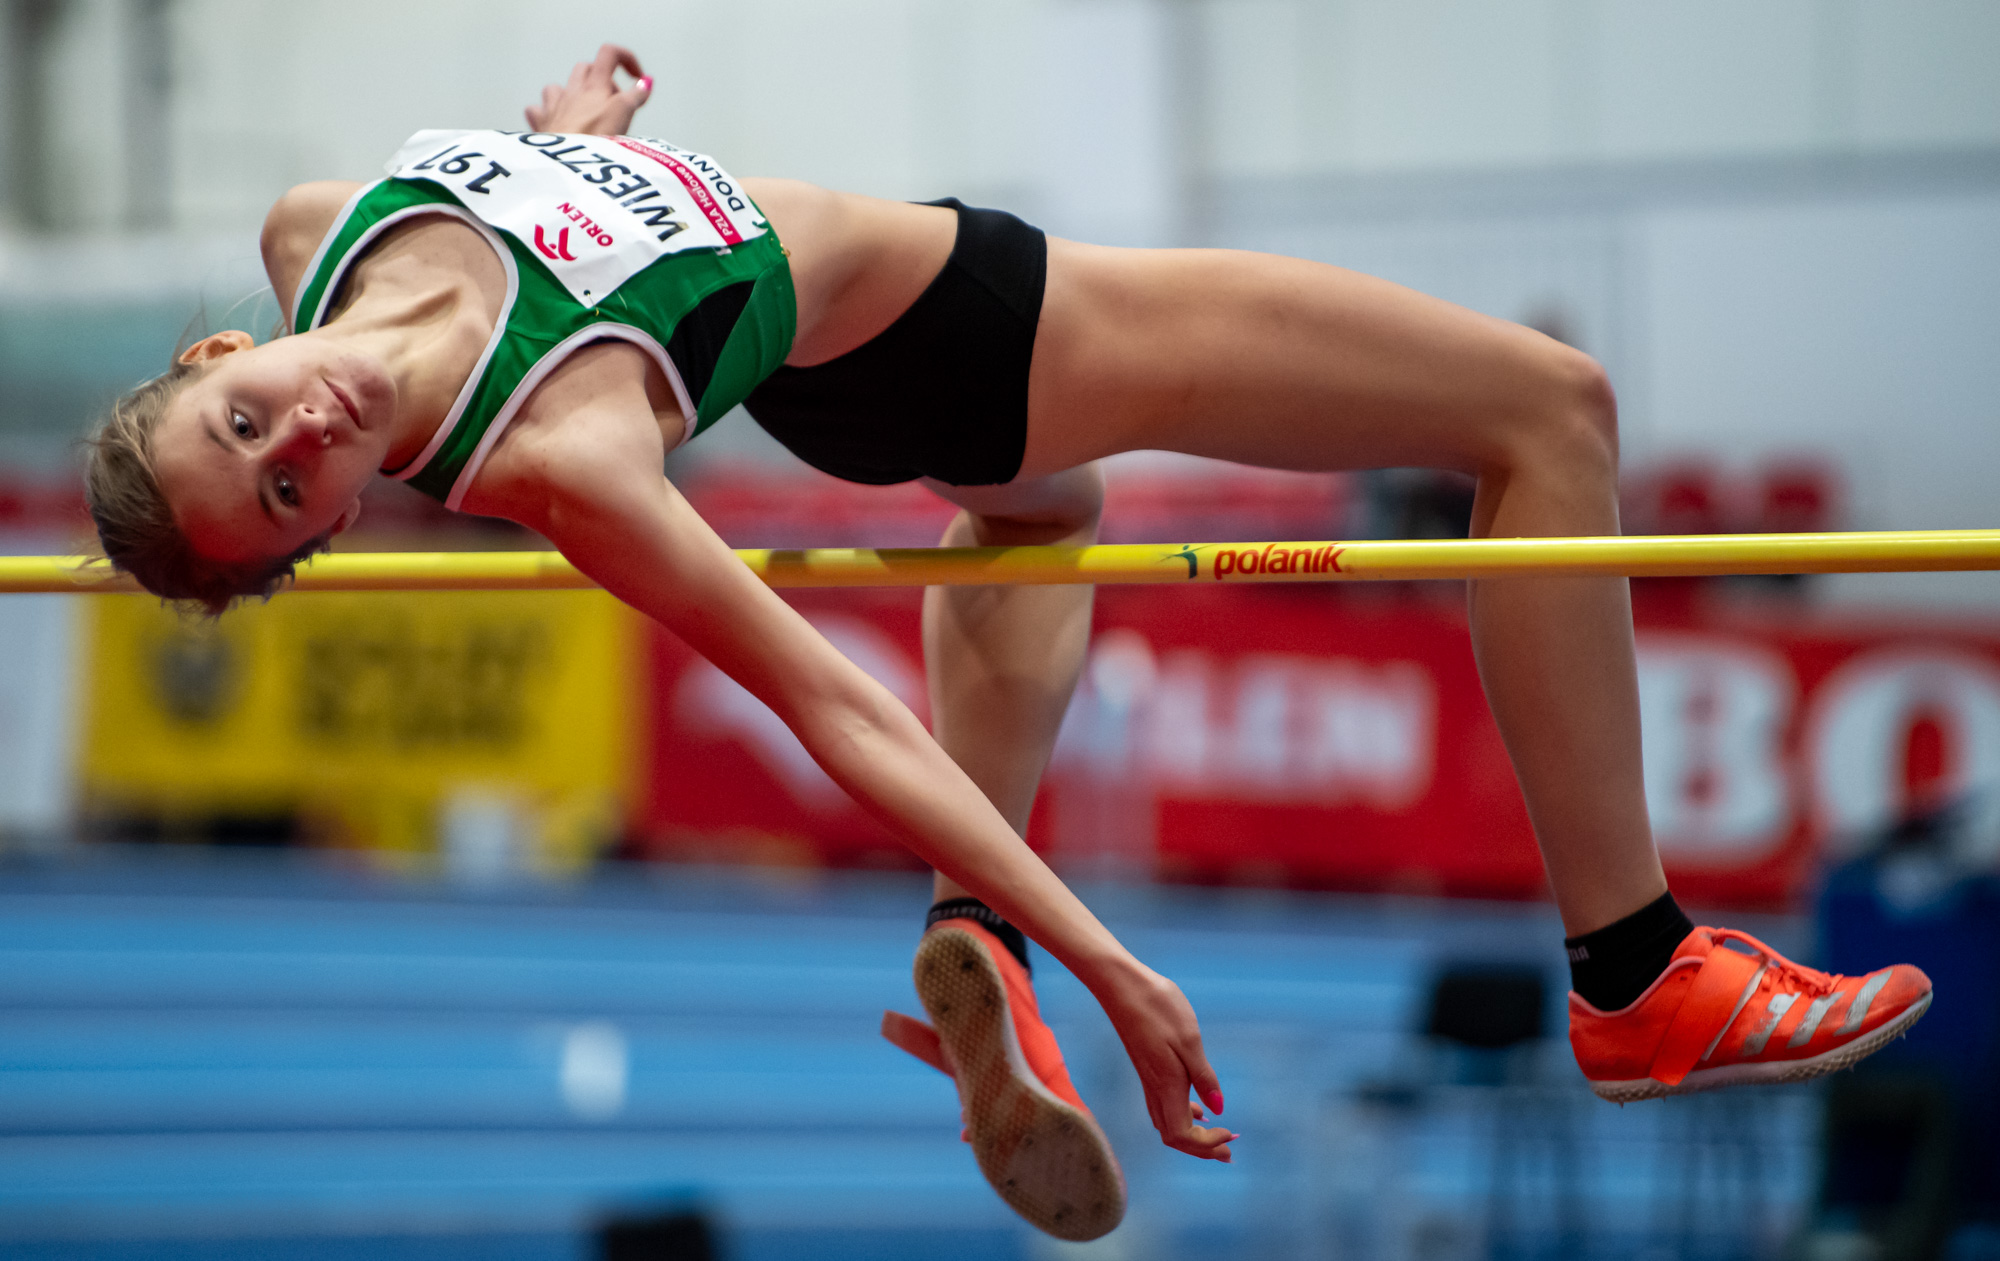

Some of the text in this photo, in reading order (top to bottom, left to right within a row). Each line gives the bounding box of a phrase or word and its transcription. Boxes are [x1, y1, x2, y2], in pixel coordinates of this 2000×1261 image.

[494, 129, 689, 242] WIESZTO
[676, 165, 734, 237] PZLA Halowe
[681, 154, 746, 212] DOLNY
[556, 202, 614, 247] ORLEN
[1214, 543, 1347, 581] polanik
